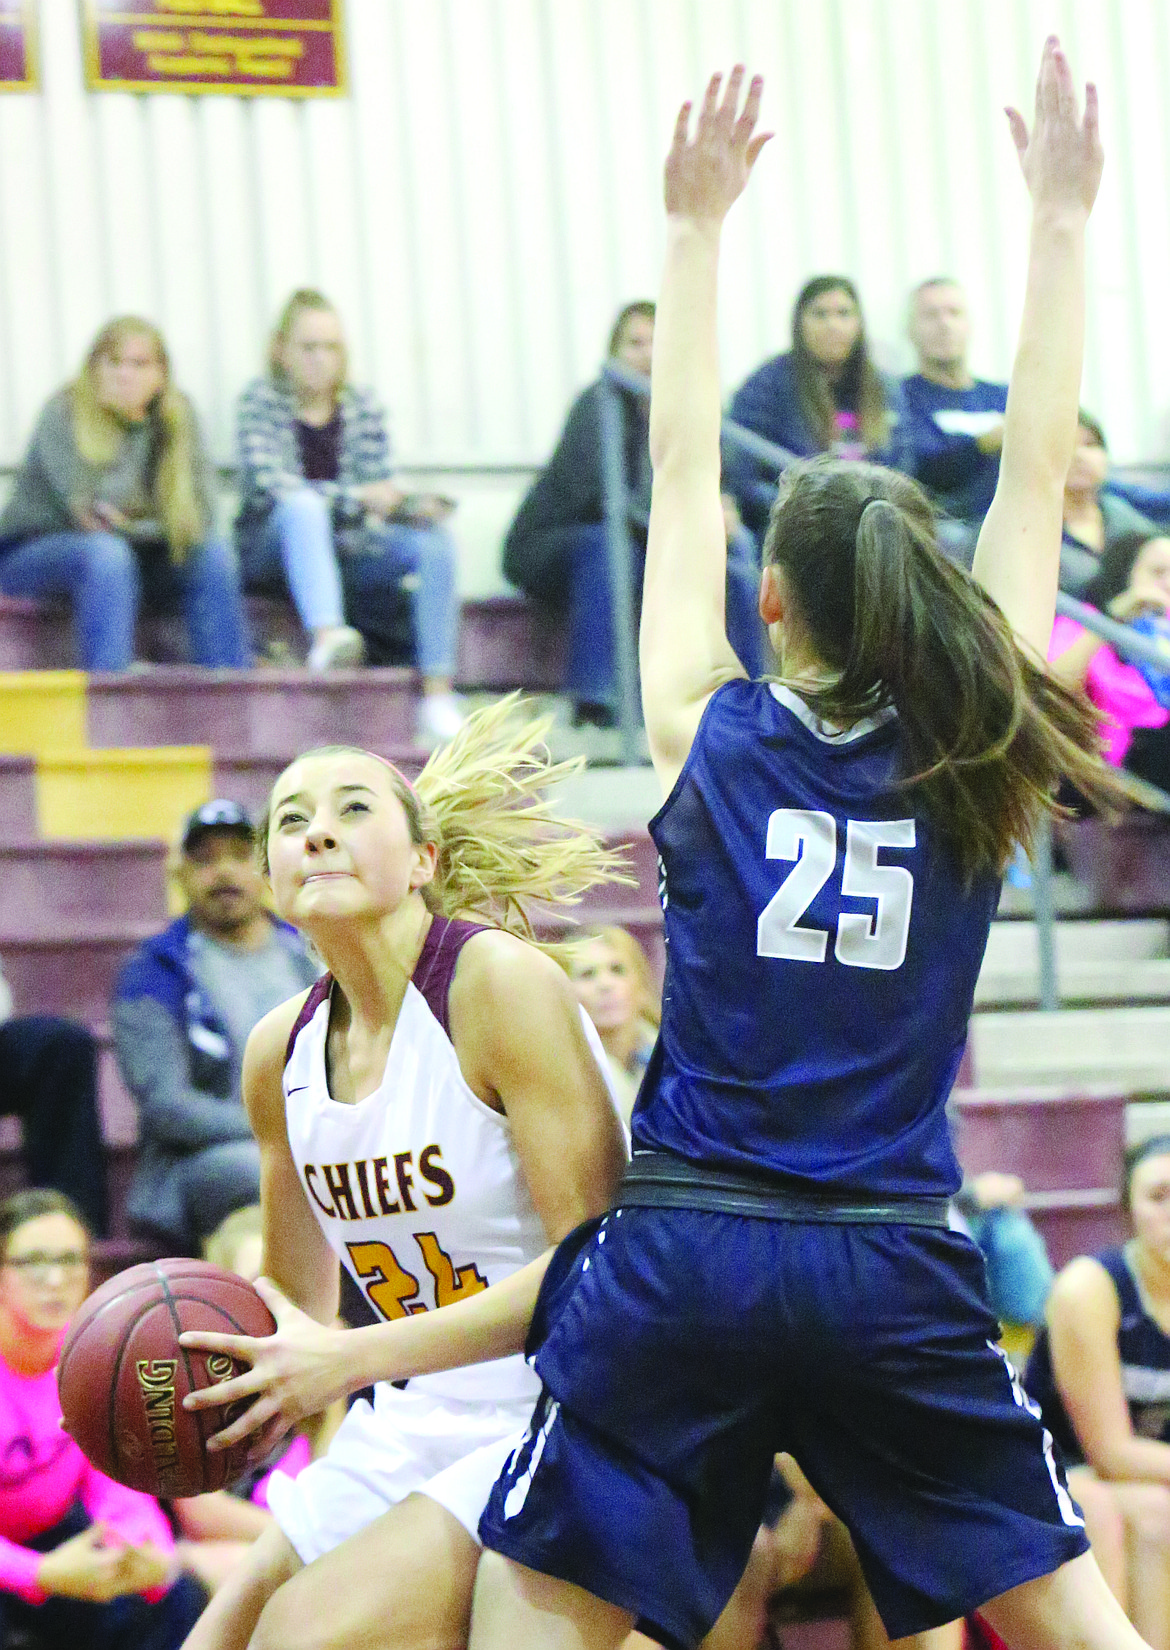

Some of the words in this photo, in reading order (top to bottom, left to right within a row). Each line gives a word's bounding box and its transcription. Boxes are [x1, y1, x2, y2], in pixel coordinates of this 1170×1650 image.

[757, 808, 916, 971] 25
[304, 1144, 455, 1221] CHIEFS
[344, 1231, 489, 1321] 24
[136, 1359, 178, 1496] ALDING
